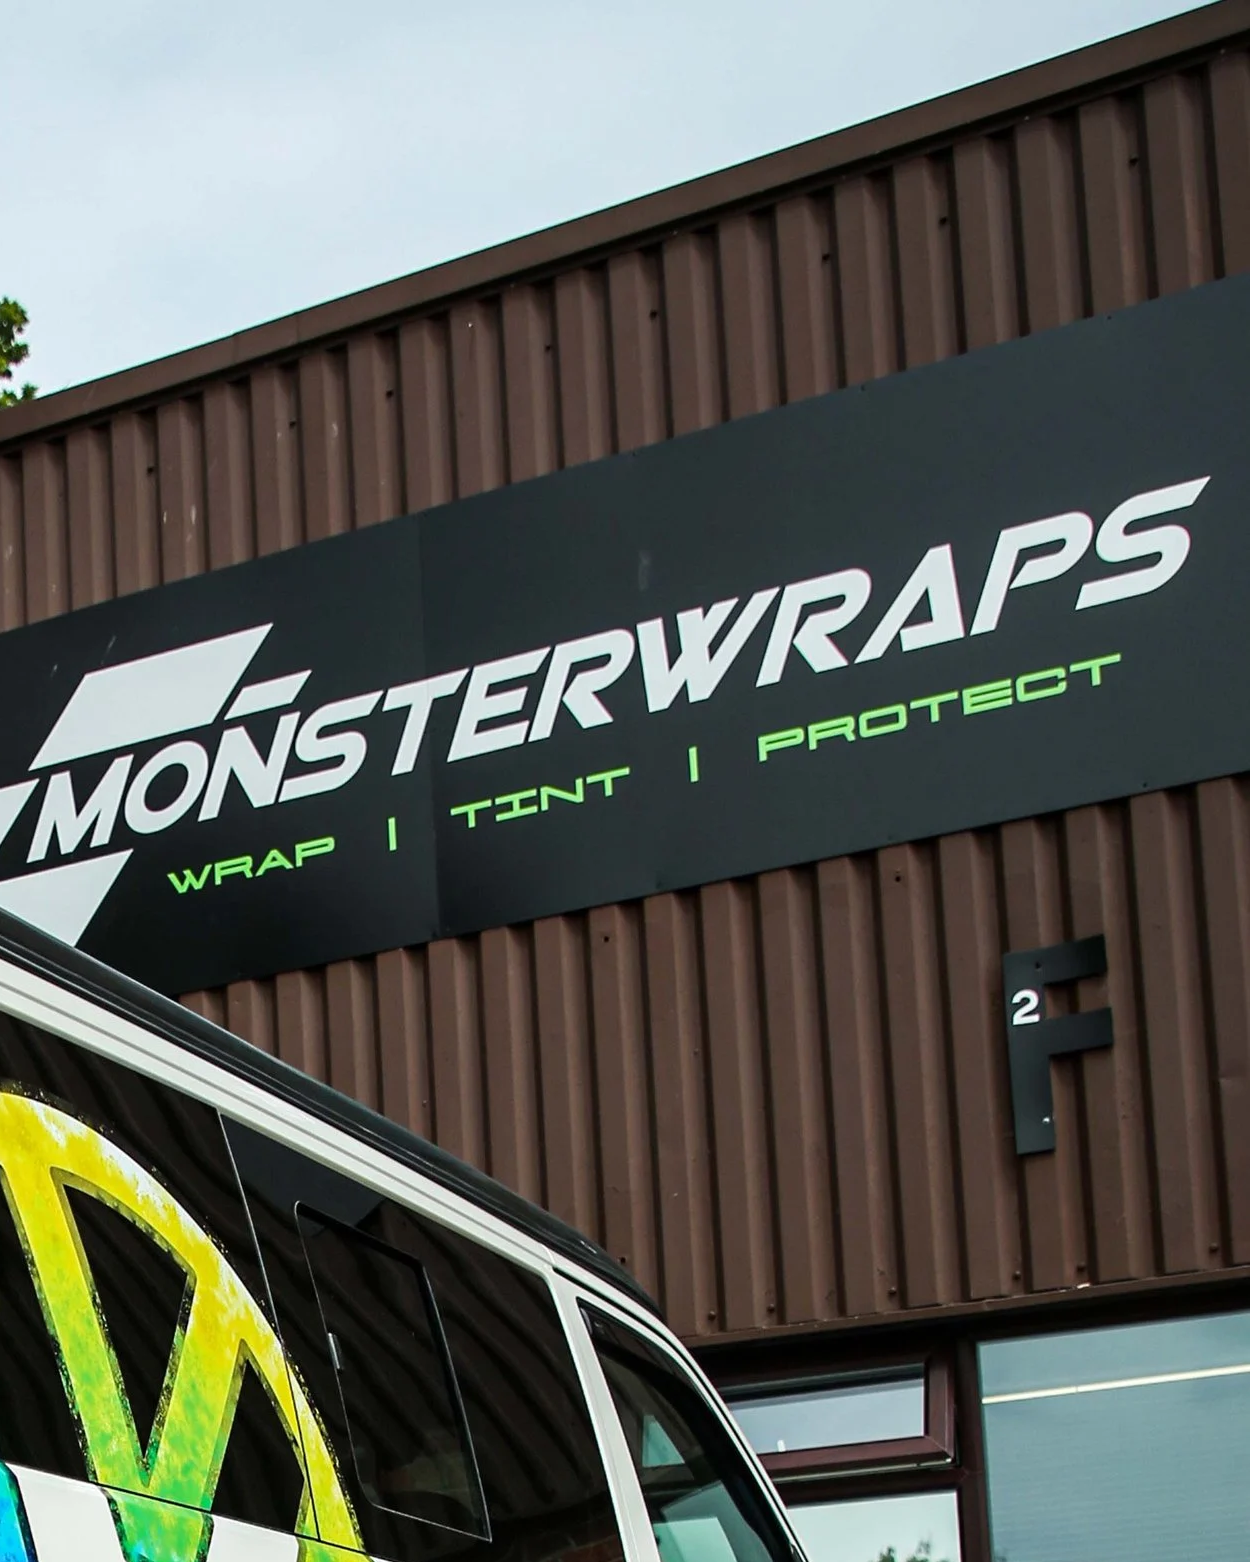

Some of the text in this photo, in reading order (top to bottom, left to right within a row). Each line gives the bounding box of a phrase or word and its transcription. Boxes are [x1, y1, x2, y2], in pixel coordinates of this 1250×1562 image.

[27, 476, 1211, 864] MONSTERWRAPS
[167, 836, 335, 894] WRAP
[450, 766, 630, 828] TINT
[757, 653, 1122, 762] PROTECT
[1012, 989, 1040, 1026] 2
